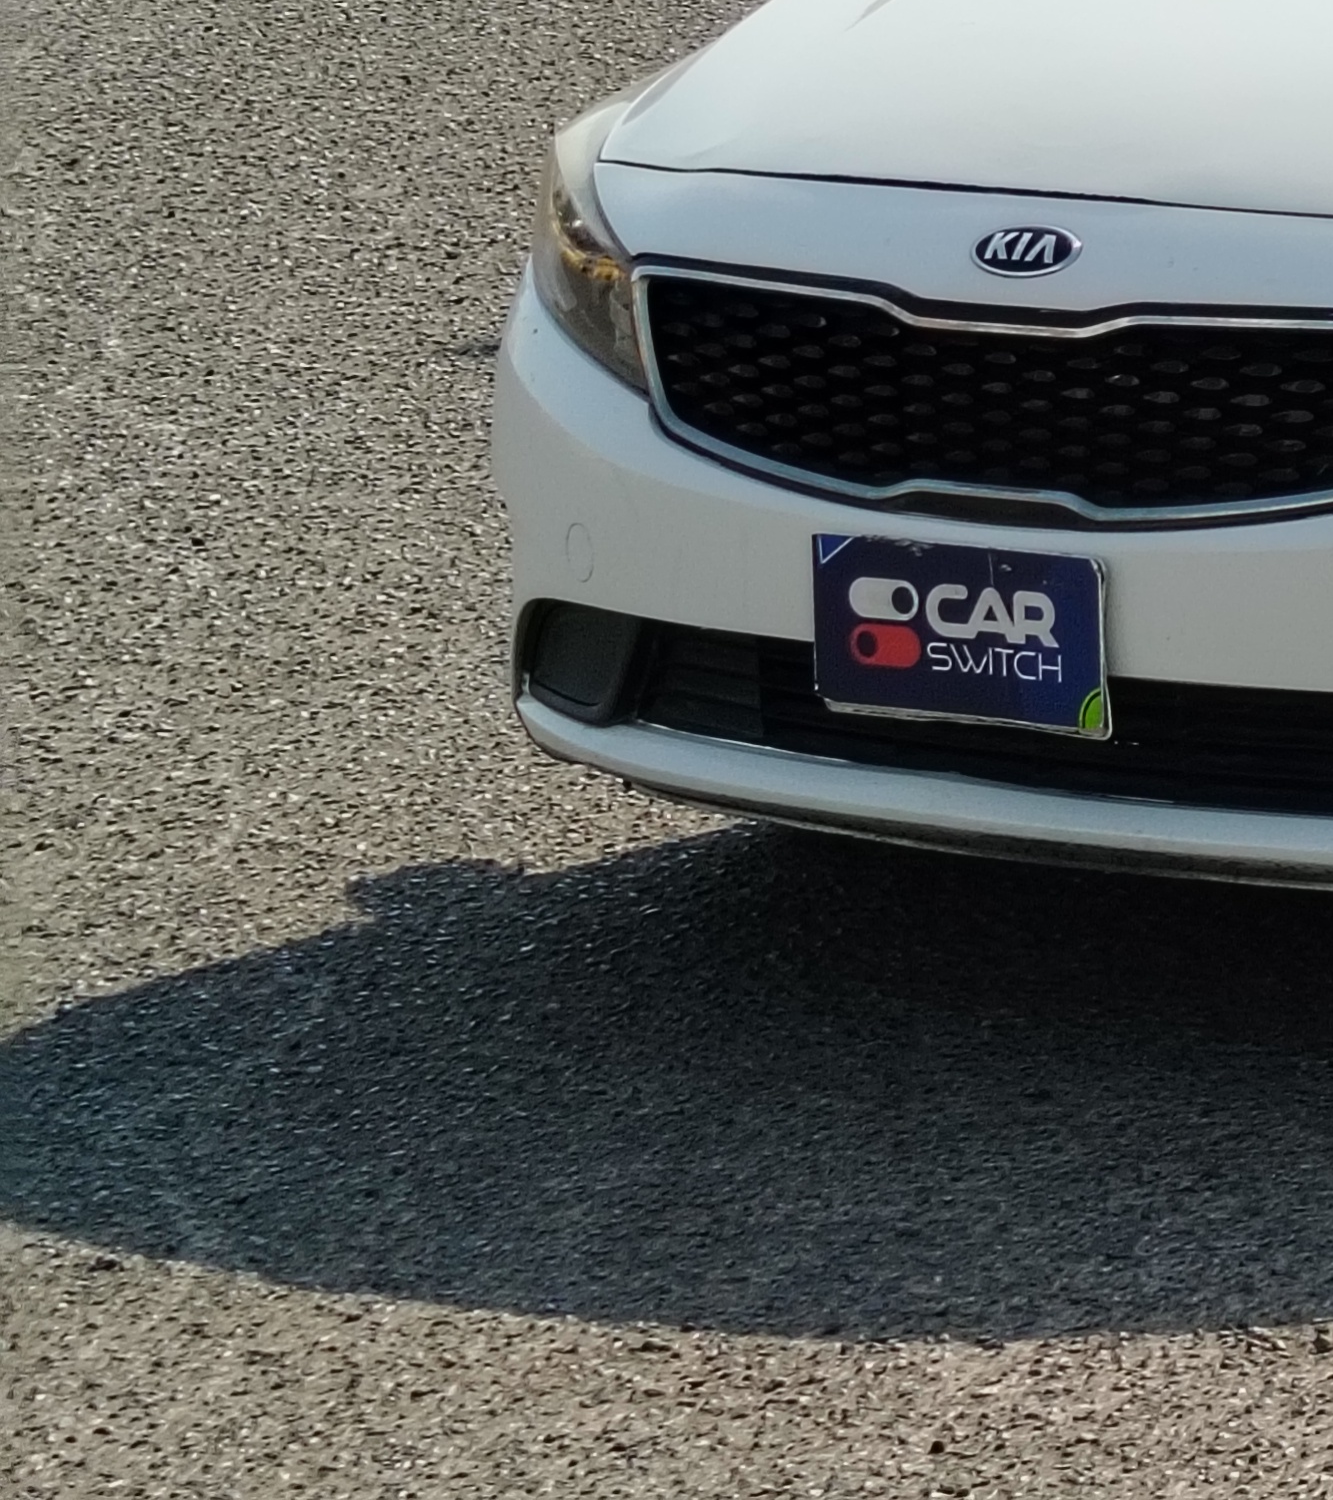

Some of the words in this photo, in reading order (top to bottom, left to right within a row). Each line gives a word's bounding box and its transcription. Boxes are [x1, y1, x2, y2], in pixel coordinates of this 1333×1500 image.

[983, 232, 1057, 264] KIA
[925, 583, 1060, 648] CAR
[926, 642, 1063, 683] SWITCH
